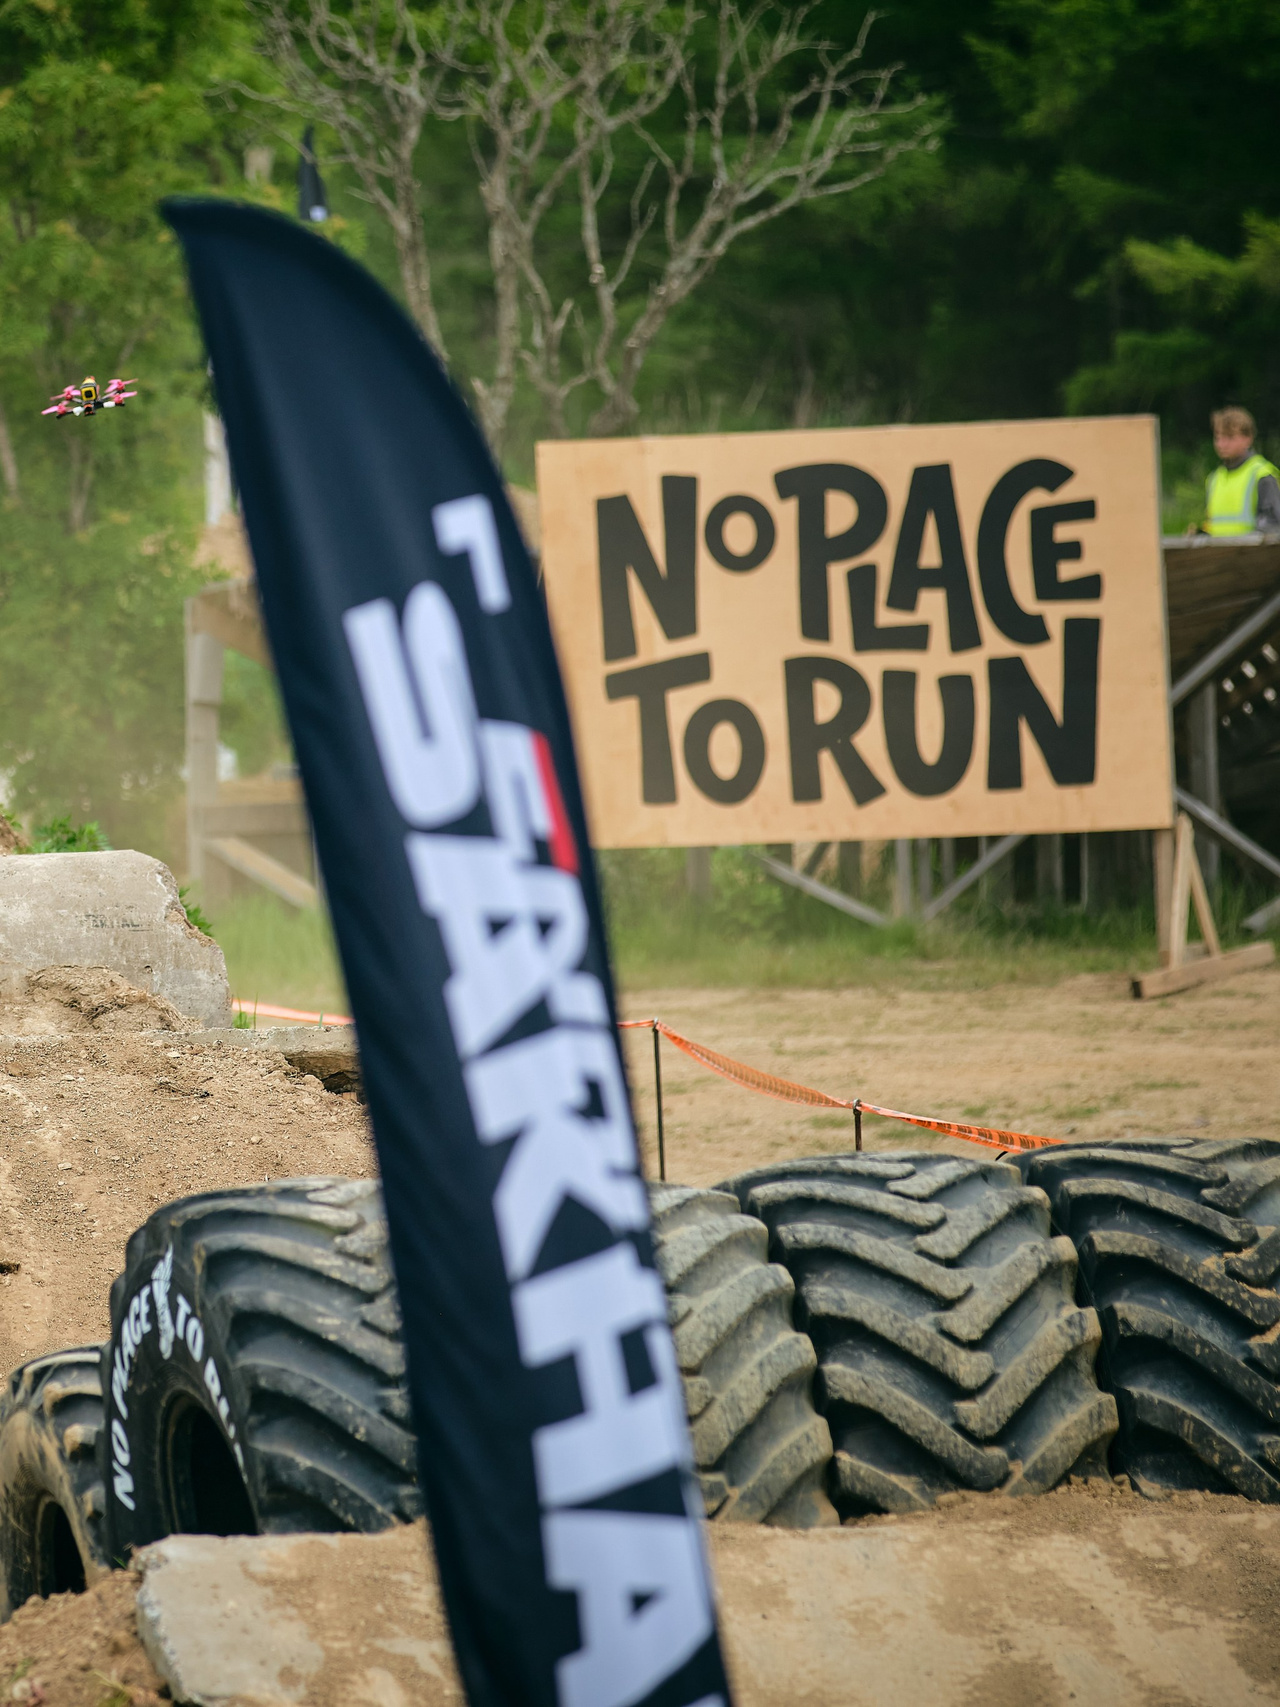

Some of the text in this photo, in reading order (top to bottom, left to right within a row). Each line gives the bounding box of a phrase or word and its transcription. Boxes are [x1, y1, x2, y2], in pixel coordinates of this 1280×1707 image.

[774, 457, 1102, 654] PLACE
[784, 617, 1101, 808] RUN
[342, 580, 724, 1707] SAKHA
[111, 1418, 136, 1512] NO
[175, 1292, 204, 1363] TO
